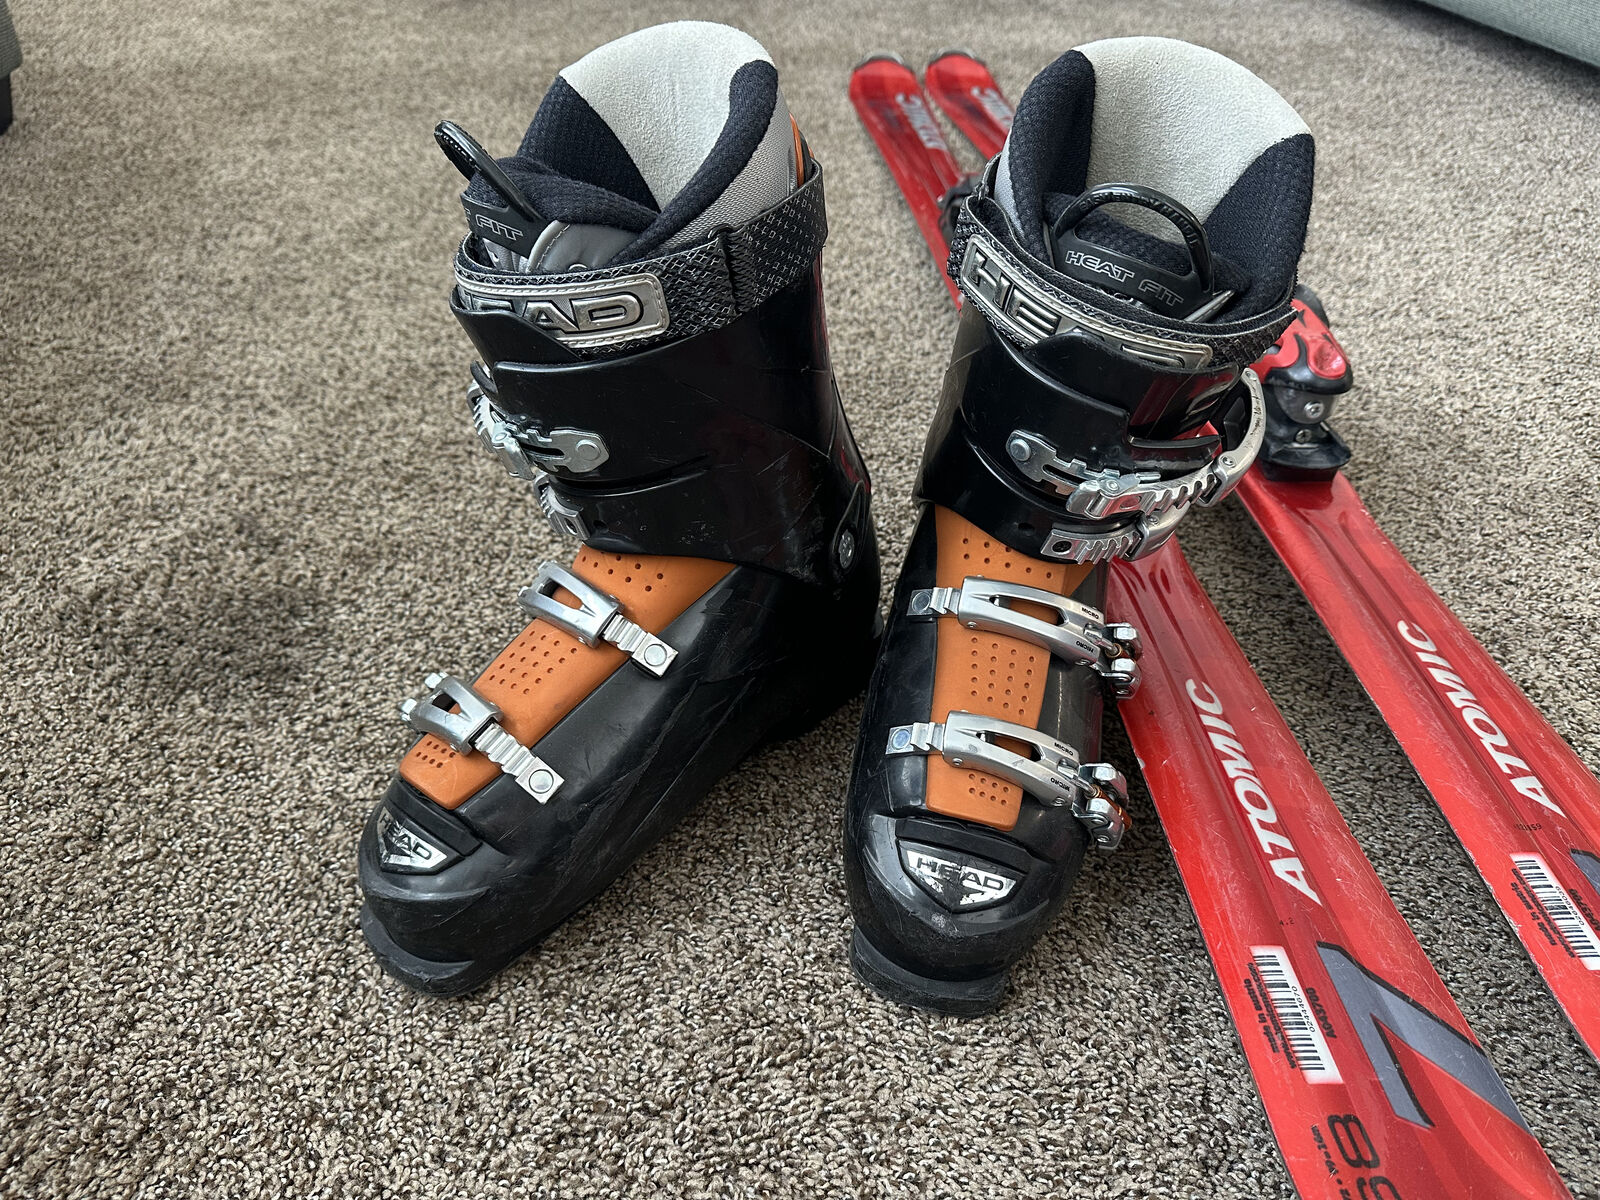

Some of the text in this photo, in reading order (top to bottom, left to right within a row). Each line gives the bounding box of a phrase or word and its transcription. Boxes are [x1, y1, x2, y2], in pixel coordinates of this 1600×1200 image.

[475, 213, 524, 241] FIT
[1065, 250, 1184, 306] HEAT FIT
[1081, 607, 1100, 620] MICRO
[1075, 640, 1095, 653] MICRO
[1396, 619, 1567, 819] ATOMIC
[1054, 742, 1074, 756] MICRO
[1050, 777, 1070, 791] MICRO
[1185, 678, 1323, 907] ATOMIC
[916, 857, 1005, 891] HEAD
[1291, 985, 1316, 1033] 02444670
[1305, 986, 1338, 1039] A043700
